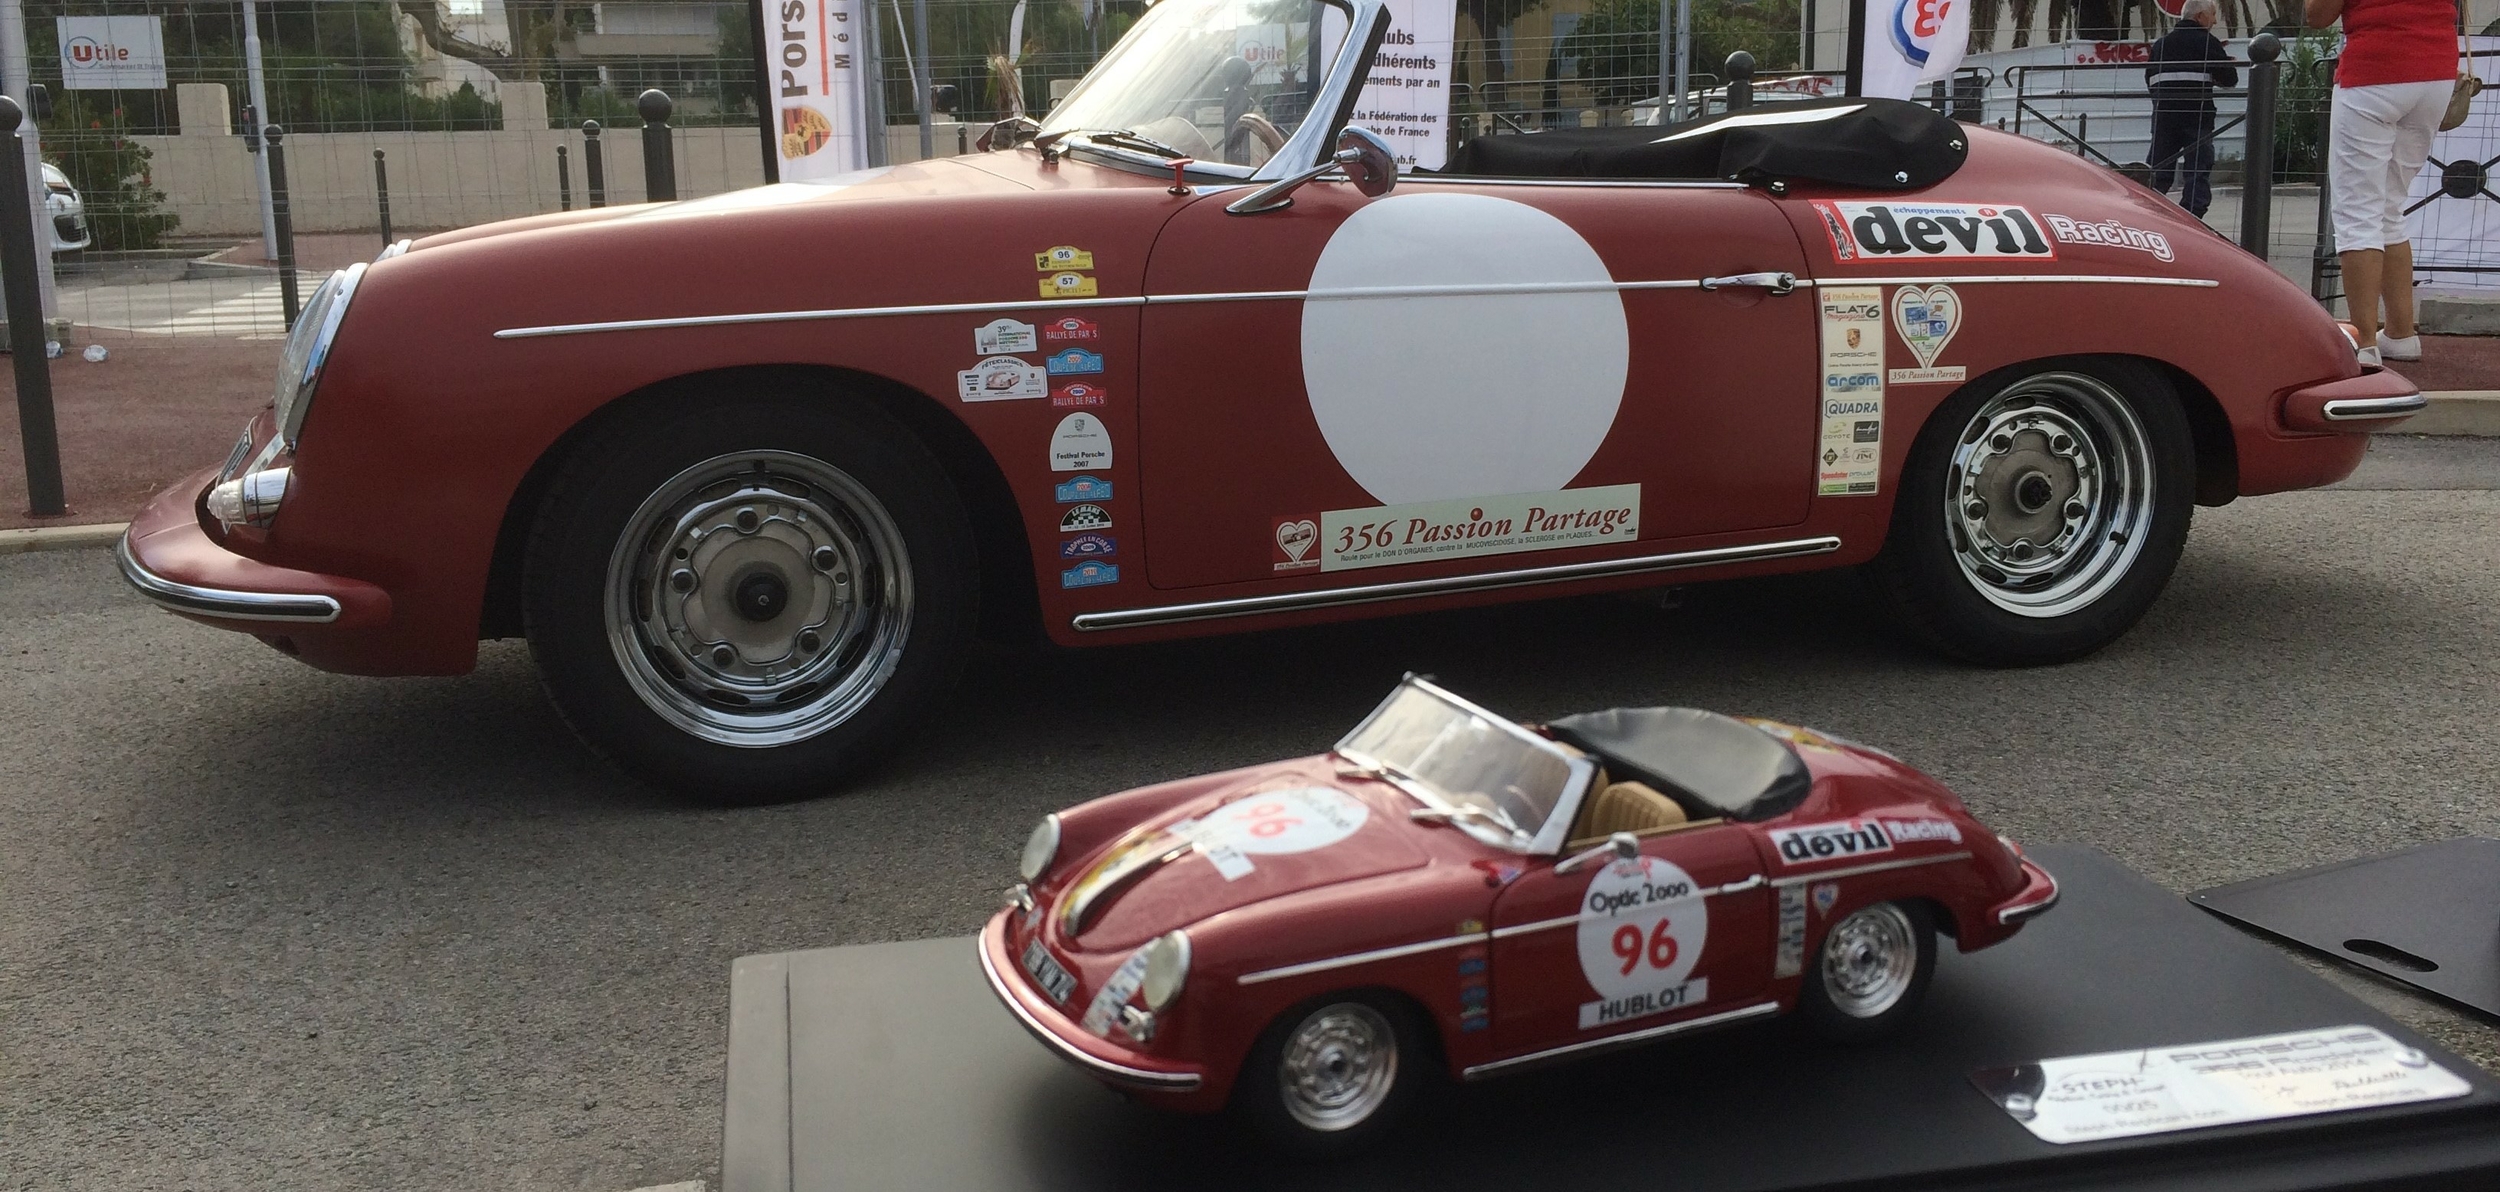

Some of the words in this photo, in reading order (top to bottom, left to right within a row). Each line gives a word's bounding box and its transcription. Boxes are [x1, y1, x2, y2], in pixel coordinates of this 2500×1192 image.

[1382, 29, 1415, 45] lubs
[73, 44, 129, 62] Utile
[1373, 53, 1436, 69] dhérents
[1364, 76, 1402, 86] ements
[1406, 79, 1424, 89] par
[1427, 80, 1440, 88] an
[1357, 110, 1366, 120] la
[1369, 111, 1418, 122] Fédération
[1420, 113, 1437, 123] des
[1384, 126, 1396, 136] de
[1398, 126, 1430, 137] France
[1853, 206, 2050, 254] devil
[2046, 215, 2172, 262] Racing
[1057, 250, 1071, 259] 96
[1062, 277, 1074, 285] 57
[1824, 305, 1867, 314] FLAT
[1865, 305, 1880, 318] 6
[1046, 331, 1067, 339] RALLYE
[1069, 330, 1077, 339] DE
[1827, 375, 1879, 387] arcom
[1891, 371, 1906, 380] 356
[1908, 370, 1935, 379] Passion
[1936, 369, 1964, 380] Partage
[1053, 397, 1074, 406] RALLYE
[1076, 397, 1084, 405] DE
[1828, 401, 1879, 415] QUADRA
[1056, 452, 1080, 460] Festival
[1081, 450, 1106, 458] Porsche
[1073, 460, 1089, 468] 2007
[1072, 507, 1081, 516] LE
[1081, 506, 1101, 515] MANS
[1334, 519, 1398, 553] 356
[1402, 508, 1512, 545] Passion
[1521, 507, 1631, 535] Partage
[1360, 553, 1373, 561] pour
[1436, 544, 1455, 552] contre
[1517, 536, 1524, 544] la
[1780, 823, 1889, 860] devil
[1590, 890, 1641, 917] Optic
[1642, 882, 1689, 902] 2000
[1612, 917, 1678, 976] 96
[1599, 985, 1688, 1022] HUBLOT
[2170, 1031, 2381, 1063] PORSCHE
